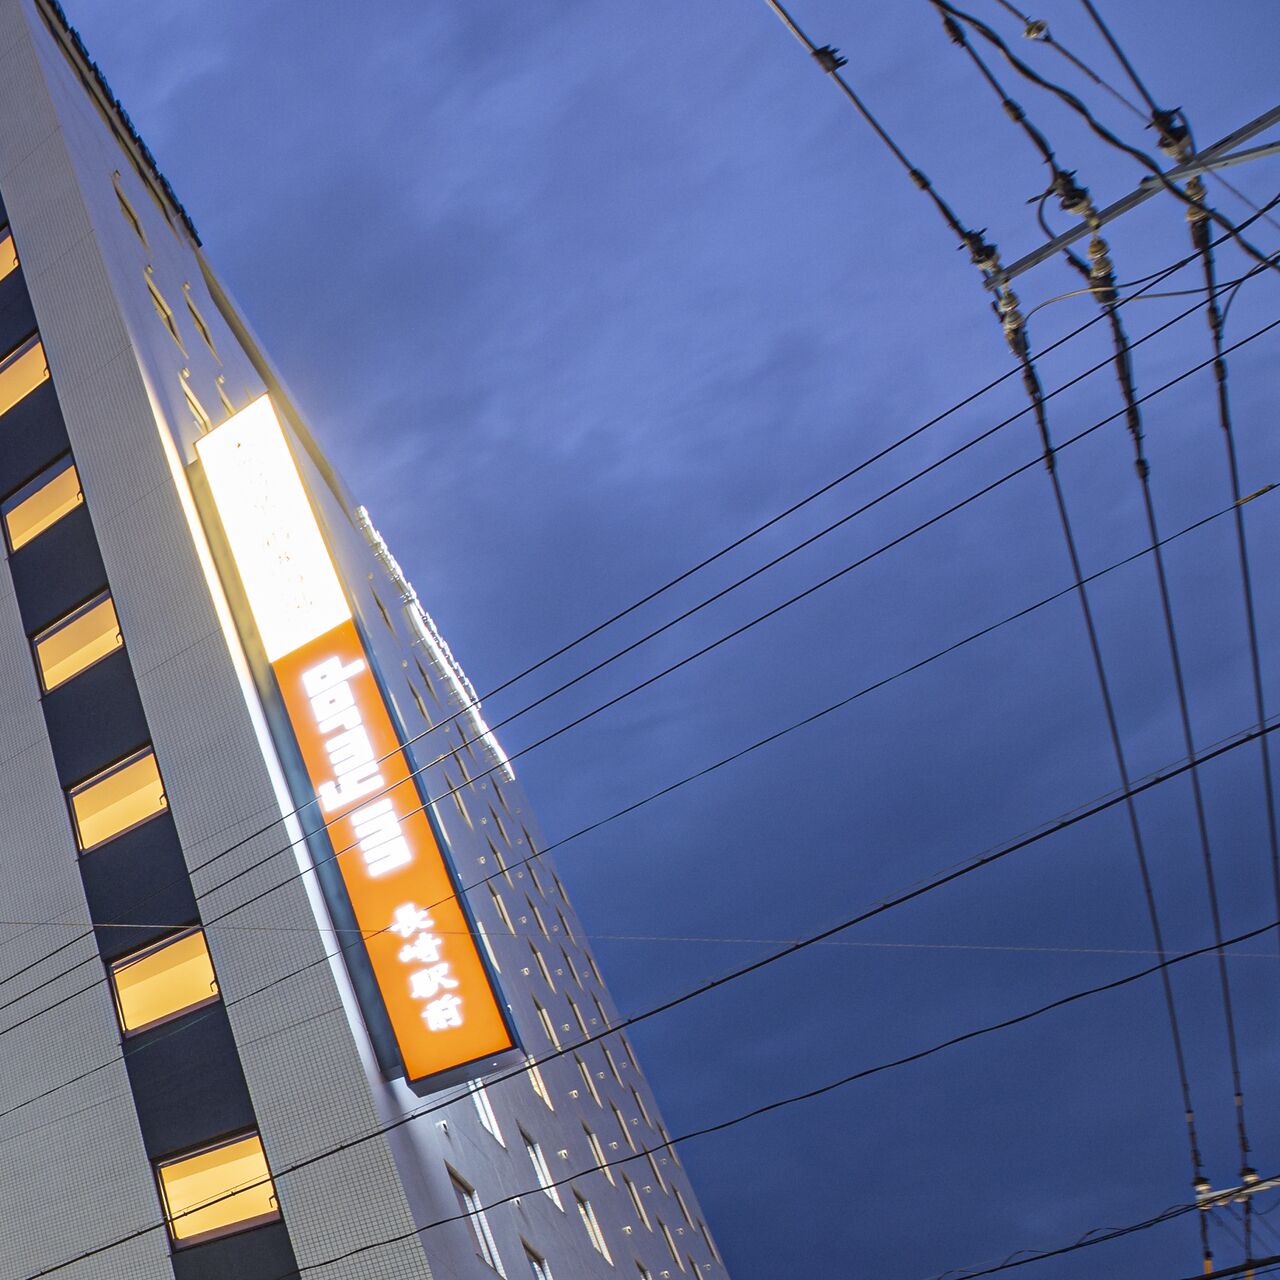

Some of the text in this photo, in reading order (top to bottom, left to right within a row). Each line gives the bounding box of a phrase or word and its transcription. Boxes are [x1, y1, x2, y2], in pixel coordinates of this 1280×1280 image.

[302, 656, 413, 877] dormy inn
[389, 903, 462, 1031] 長崎駅前
